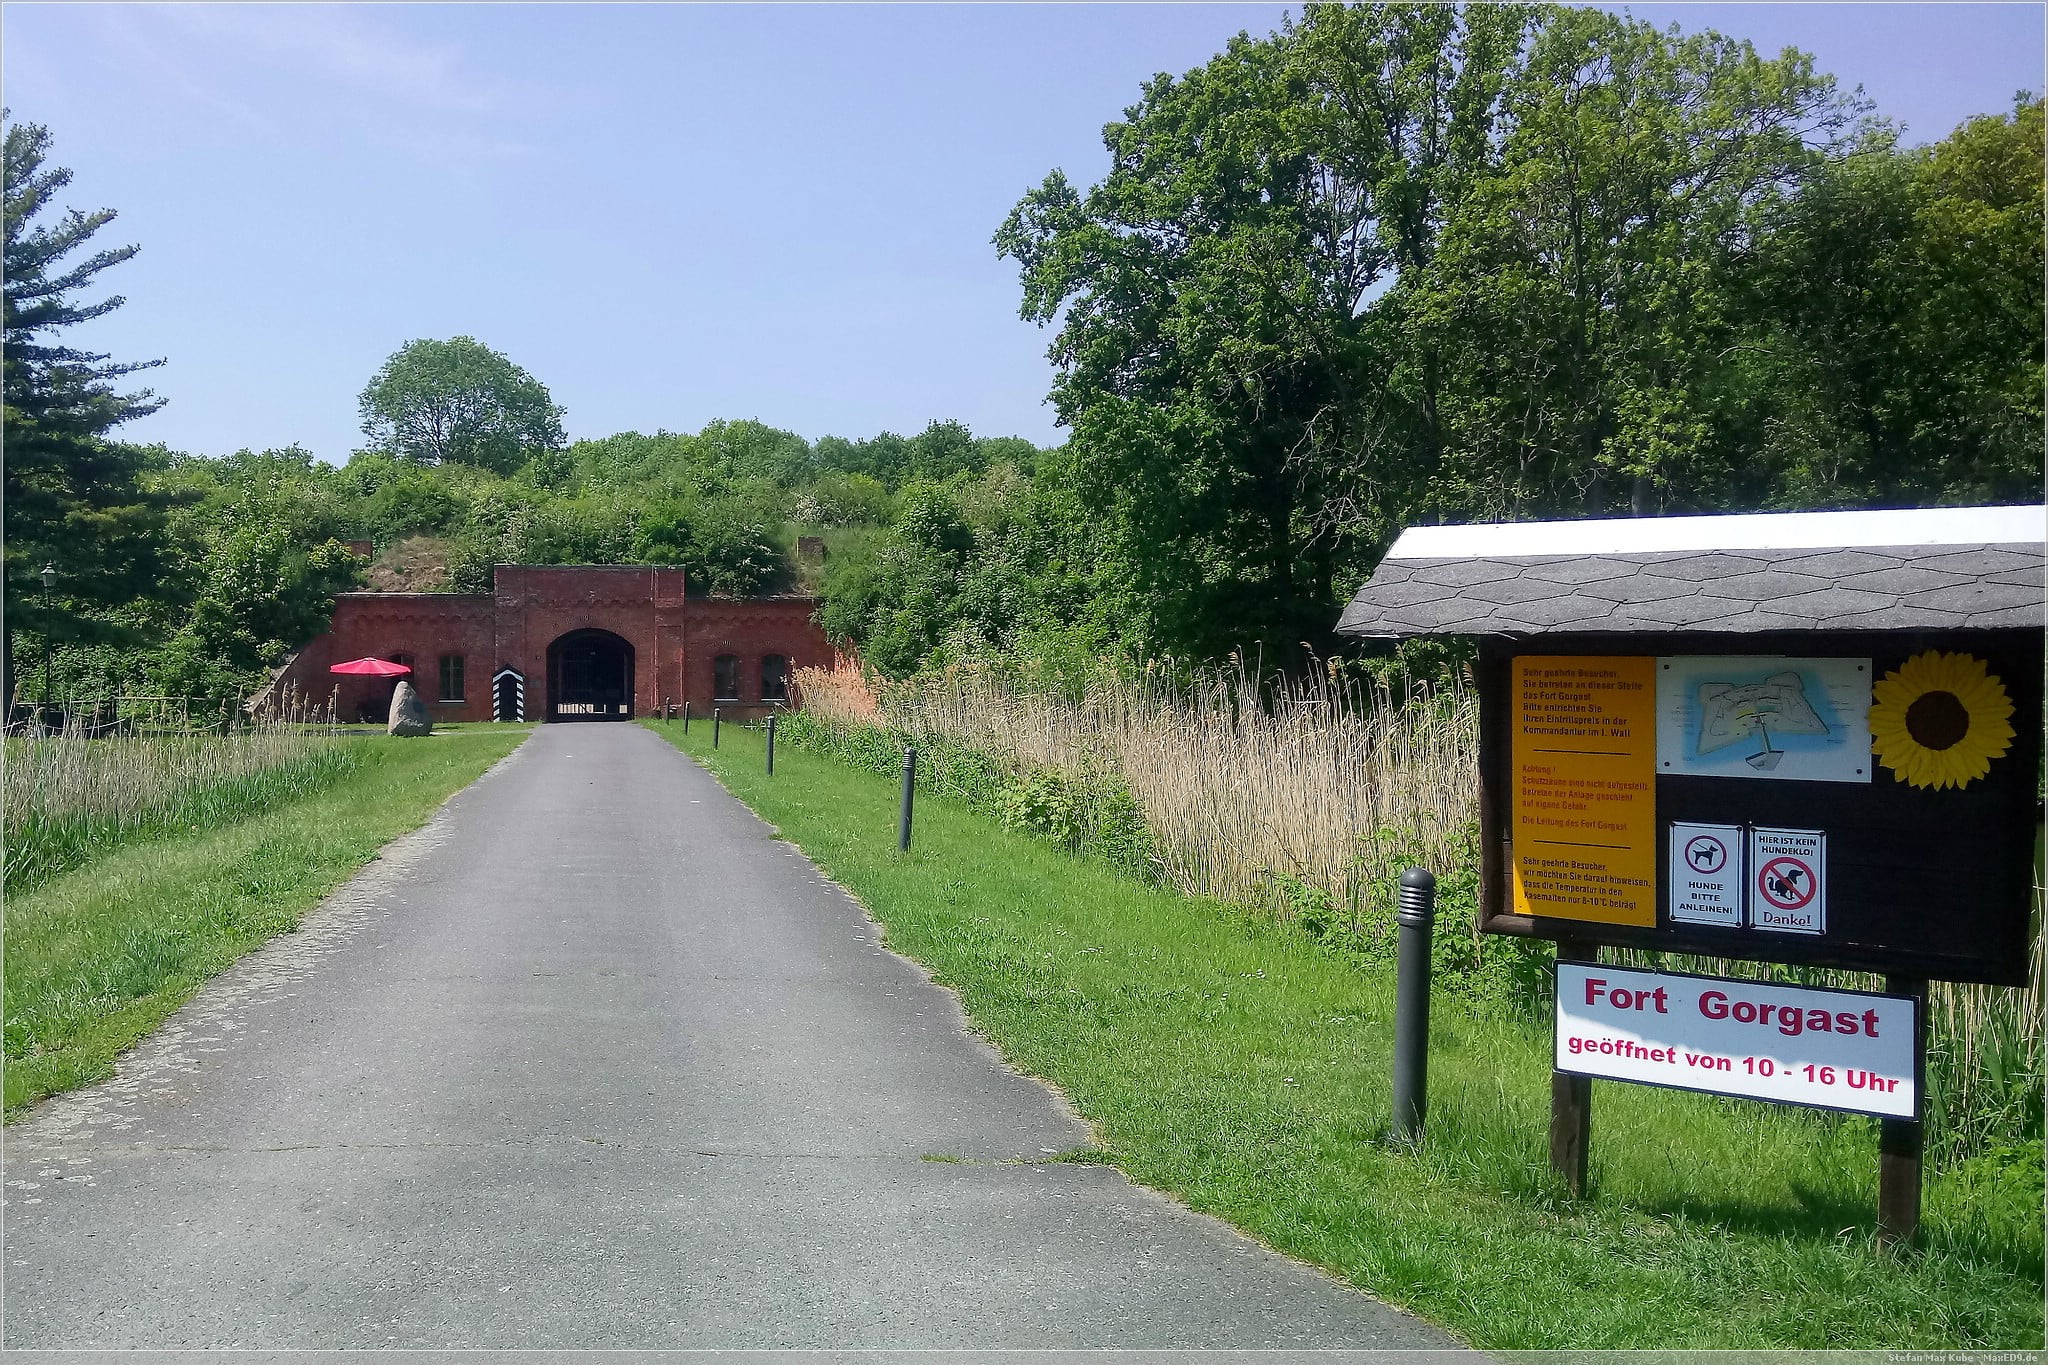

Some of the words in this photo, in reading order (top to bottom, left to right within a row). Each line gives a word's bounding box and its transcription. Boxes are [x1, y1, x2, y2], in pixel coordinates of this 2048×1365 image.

[1523, 669, 1542, 677] Sehr
[1523, 680, 1536, 688] Sie
[1539, 680, 1573, 688] betreten
[1588, 681, 1615, 689] dieser
[1617, 682, 1643, 690] Stelle
[1523, 703, 1541, 711] Bitte
[1544, 703, 1586, 712] entrichten
[1588, 704, 1602, 712] Sie
[1523, 714, 1544, 722] Ihren
[1547, 715, 1600, 725] Eintrittspreis
[1613, 717, 1627, 725] der
[1524, 726, 1585, 736] Kommandantur
[1588, 728, 1599, 736] im
[1611, 729, 1630, 737] Wall
[1522, 765, 1551, 775] Achtung
[1522, 788, 1552, 796] Betreten
[1569, 790, 1594, 800] Anlage
[1522, 816, 1534, 824] Die
[1536, 816, 1563, 828] Leitung
[1566, 819, 1578, 827] des
[1581, 820, 1596, 828] Fort
[1758, 836, 1778, 844] HIER
[1781, 837, 1794, 845] IST
[1796, 838, 1817, 846] KEIN
[1523, 857, 1539, 865] Sehr
[1542, 859, 1569, 868] geehrte
[1570, 872, 1581, 880] Sie
[1584, 874, 1608, 882] darauf
[1524, 880, 1540, 888] dass
[1542, 881, 1554, 889] die
[1556, 882, 1597, 892] Temperatur
[1608, 887, 1623, 896] den
[1688, 881, 1724, 890] HUNDE
[1524, 891, 1566, 902] Kasematten
[1568, 896, 1580, 904] nur
[1691, 893, 1721, 902] BITTE
[1679, 903, 1733, 914] ANLEINEN!
[1763, 912, 1812, 926] Danke!
[1584, 978, 1668, 1014] Fort
[1698, 990, 1880, 1038] Gorgast
[1568, 1035, 1676, 1064] geöffnet
[1686, 1053, 1731, 1072] von
[1742, 1057, 1774, 1077] 10
[1802, 1064, 1835, 1085] 16
[1847, 1069, 1900, 1093] Uhr
